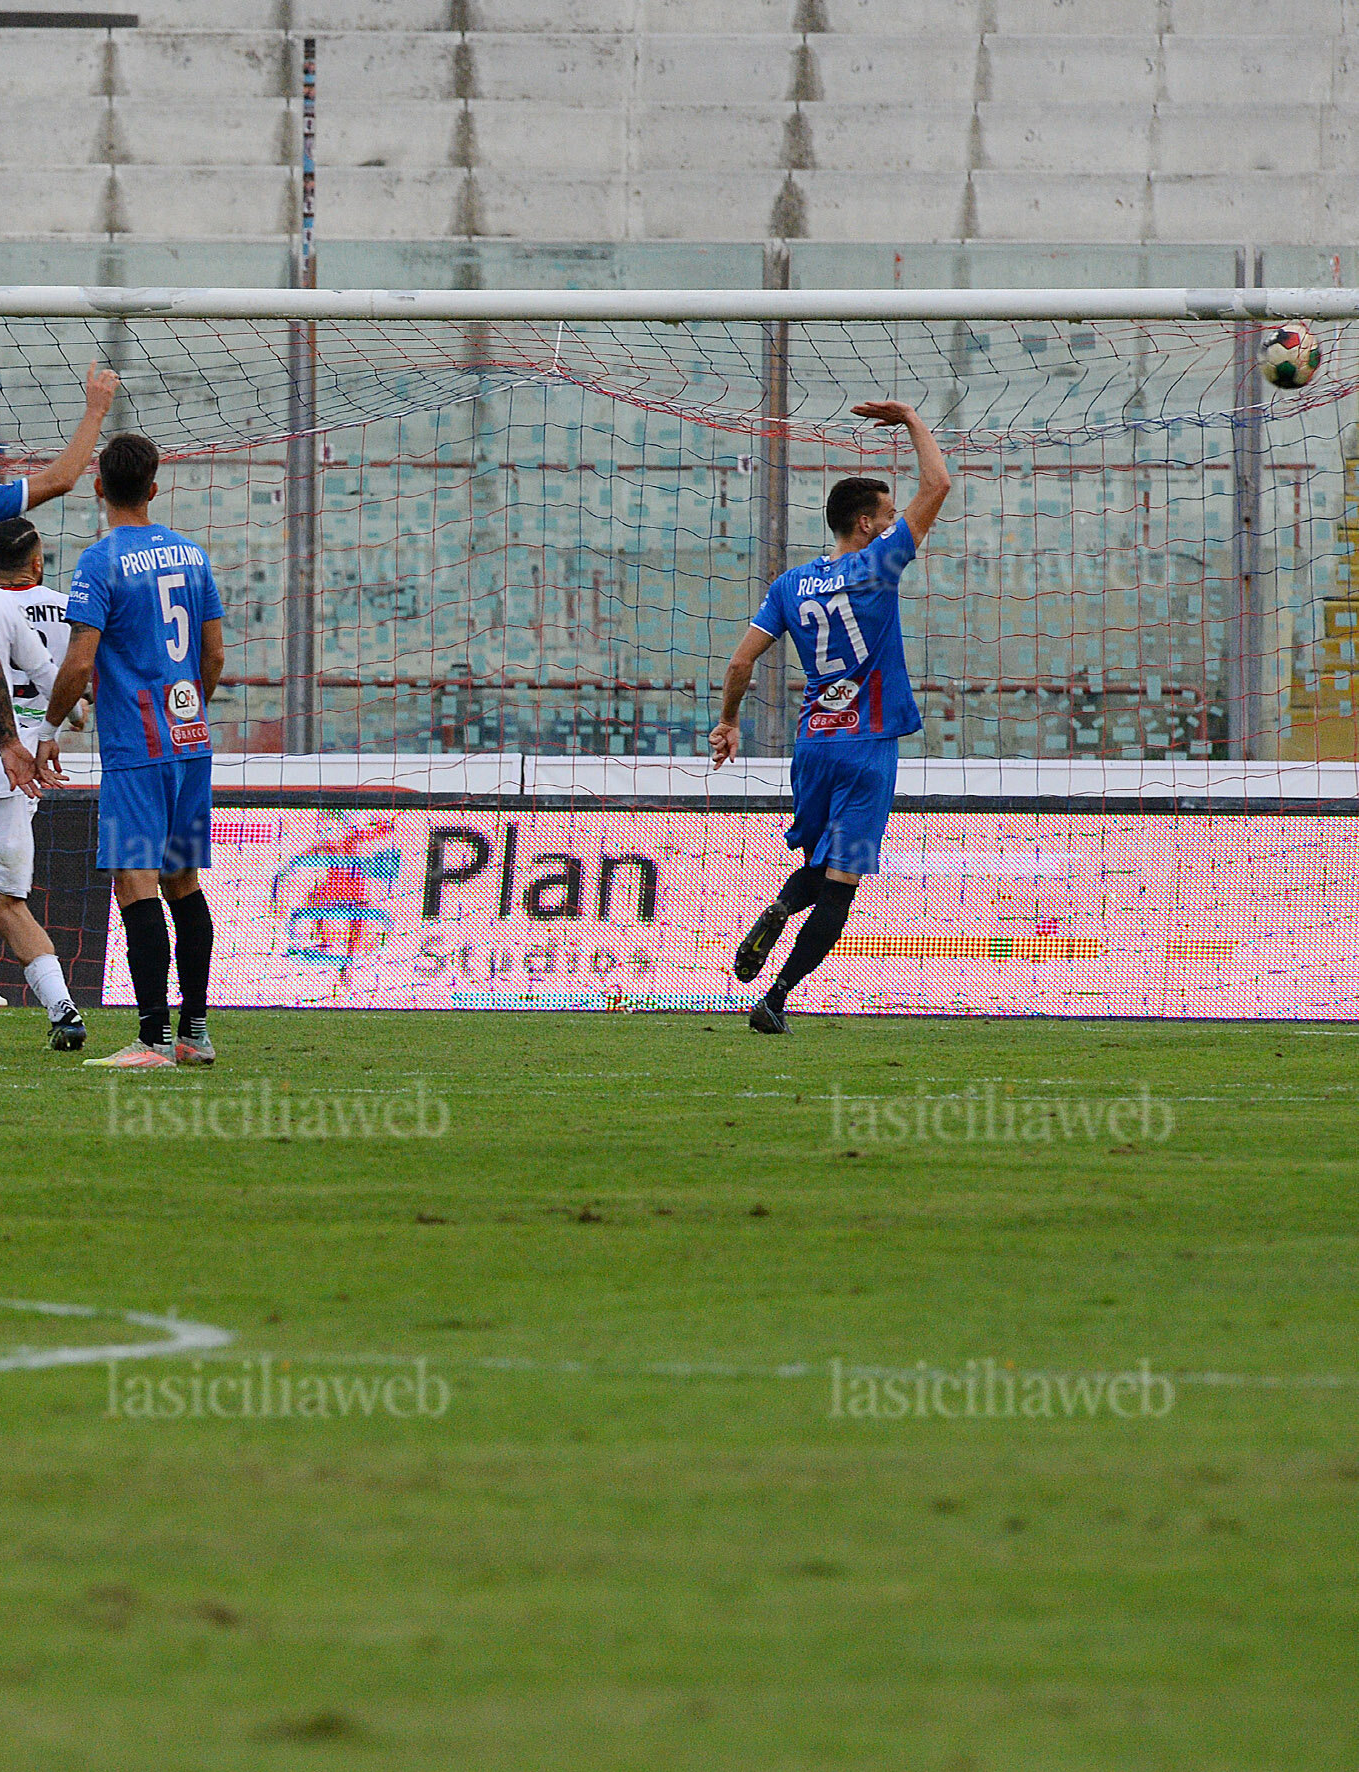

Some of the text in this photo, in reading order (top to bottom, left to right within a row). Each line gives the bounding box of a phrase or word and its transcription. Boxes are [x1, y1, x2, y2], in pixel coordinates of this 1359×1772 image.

[120, 545, 204, 577] PROVENZANO
[797, 574, 846, 597] ROPOLO
[26, 604, 67, 623] ANTE
[157, 573, 189, 663] 5
[798, 592, 869, 676] 21
[182, 727, 208, 739] BACCO
[422, 821, 659, 922] Plan
[415, 936, 656, 980] Studios
